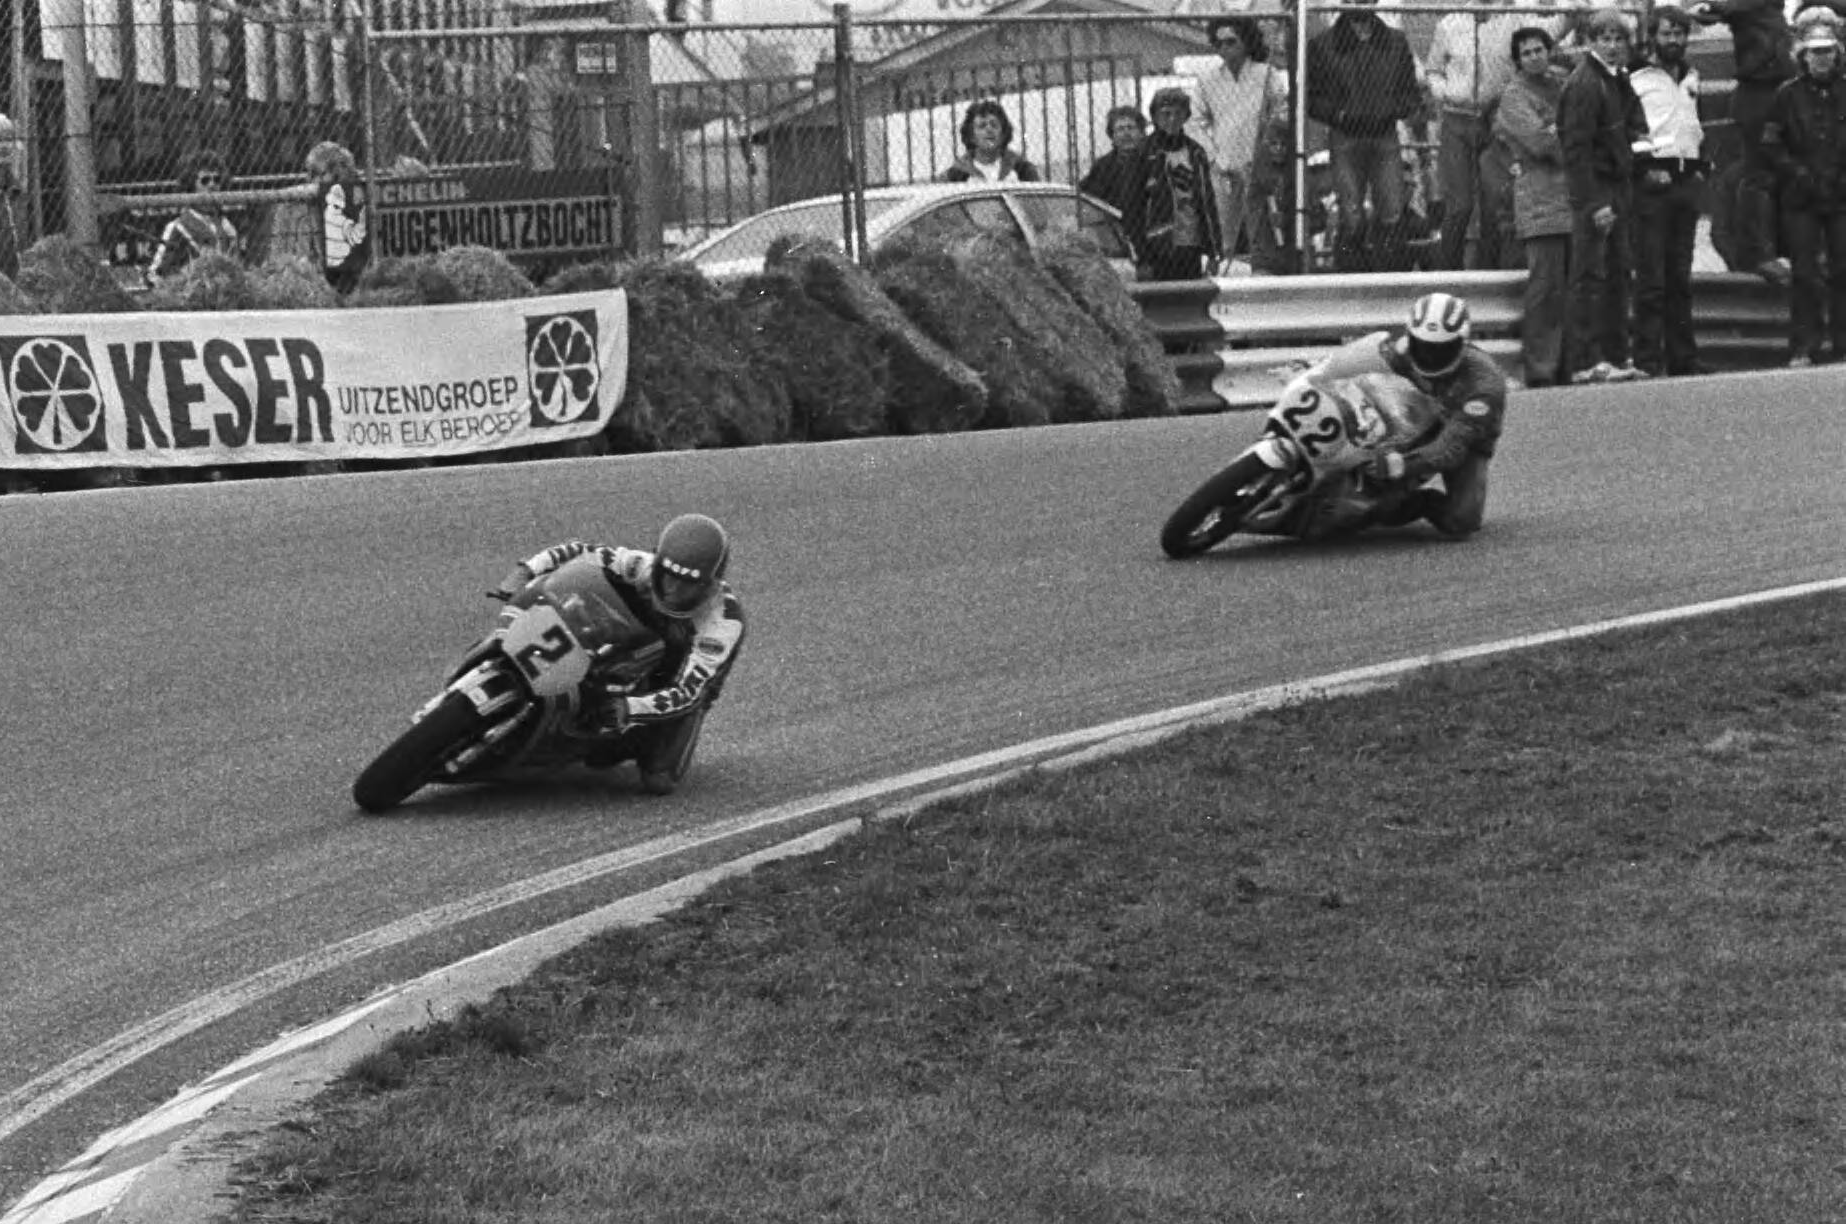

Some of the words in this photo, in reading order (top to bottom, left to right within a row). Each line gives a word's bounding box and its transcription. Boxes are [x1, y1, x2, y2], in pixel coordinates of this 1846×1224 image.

[106, 338, 335, 450] KESER
[337, 376, 518, 415] UITZENDGROEP
[1282, 388, 1342, 458] 22
[401, 419, 436, 444] ELK
[440, 410, 521, 441] BEROEP
[515, 623, 575, 681] 2
